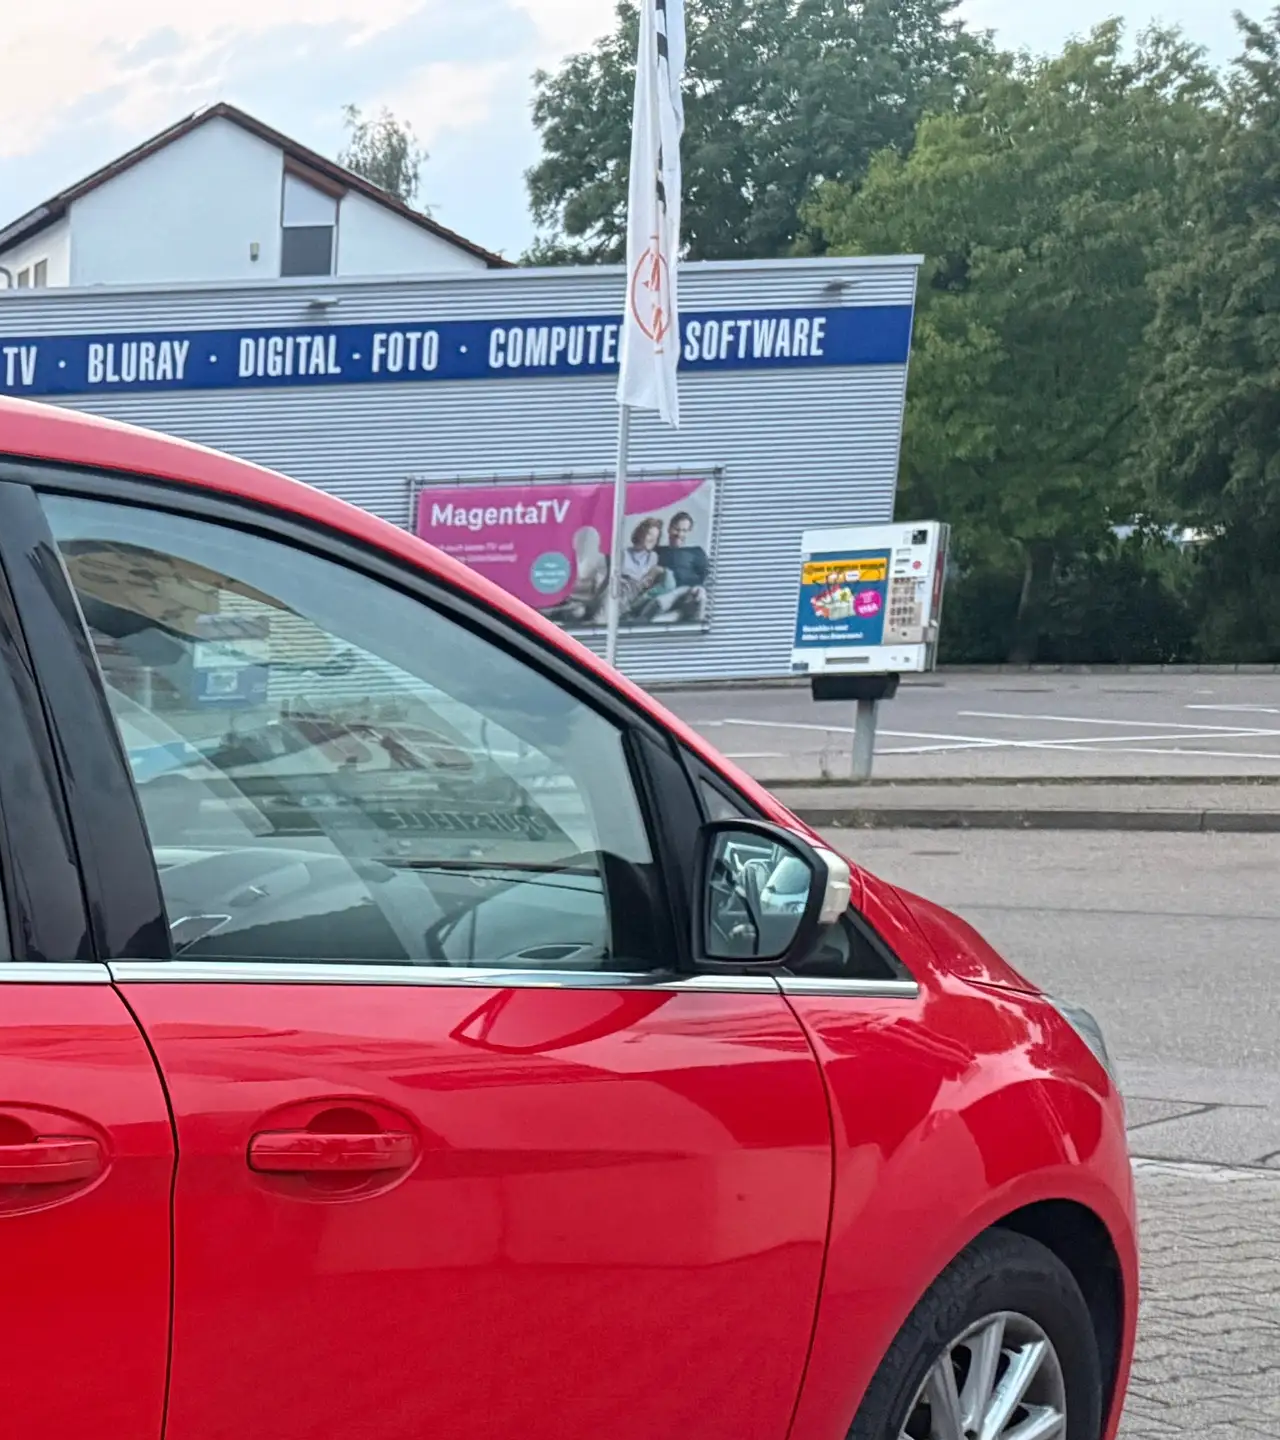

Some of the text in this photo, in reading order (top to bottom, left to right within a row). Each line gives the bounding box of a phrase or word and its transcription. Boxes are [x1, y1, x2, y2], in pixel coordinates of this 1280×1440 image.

[3, 317, 826, 386] TV BLURAY DIGITAL FOTO COMPUTE SOFTWARE
[431, 499, 570, 531] MagentaTV
